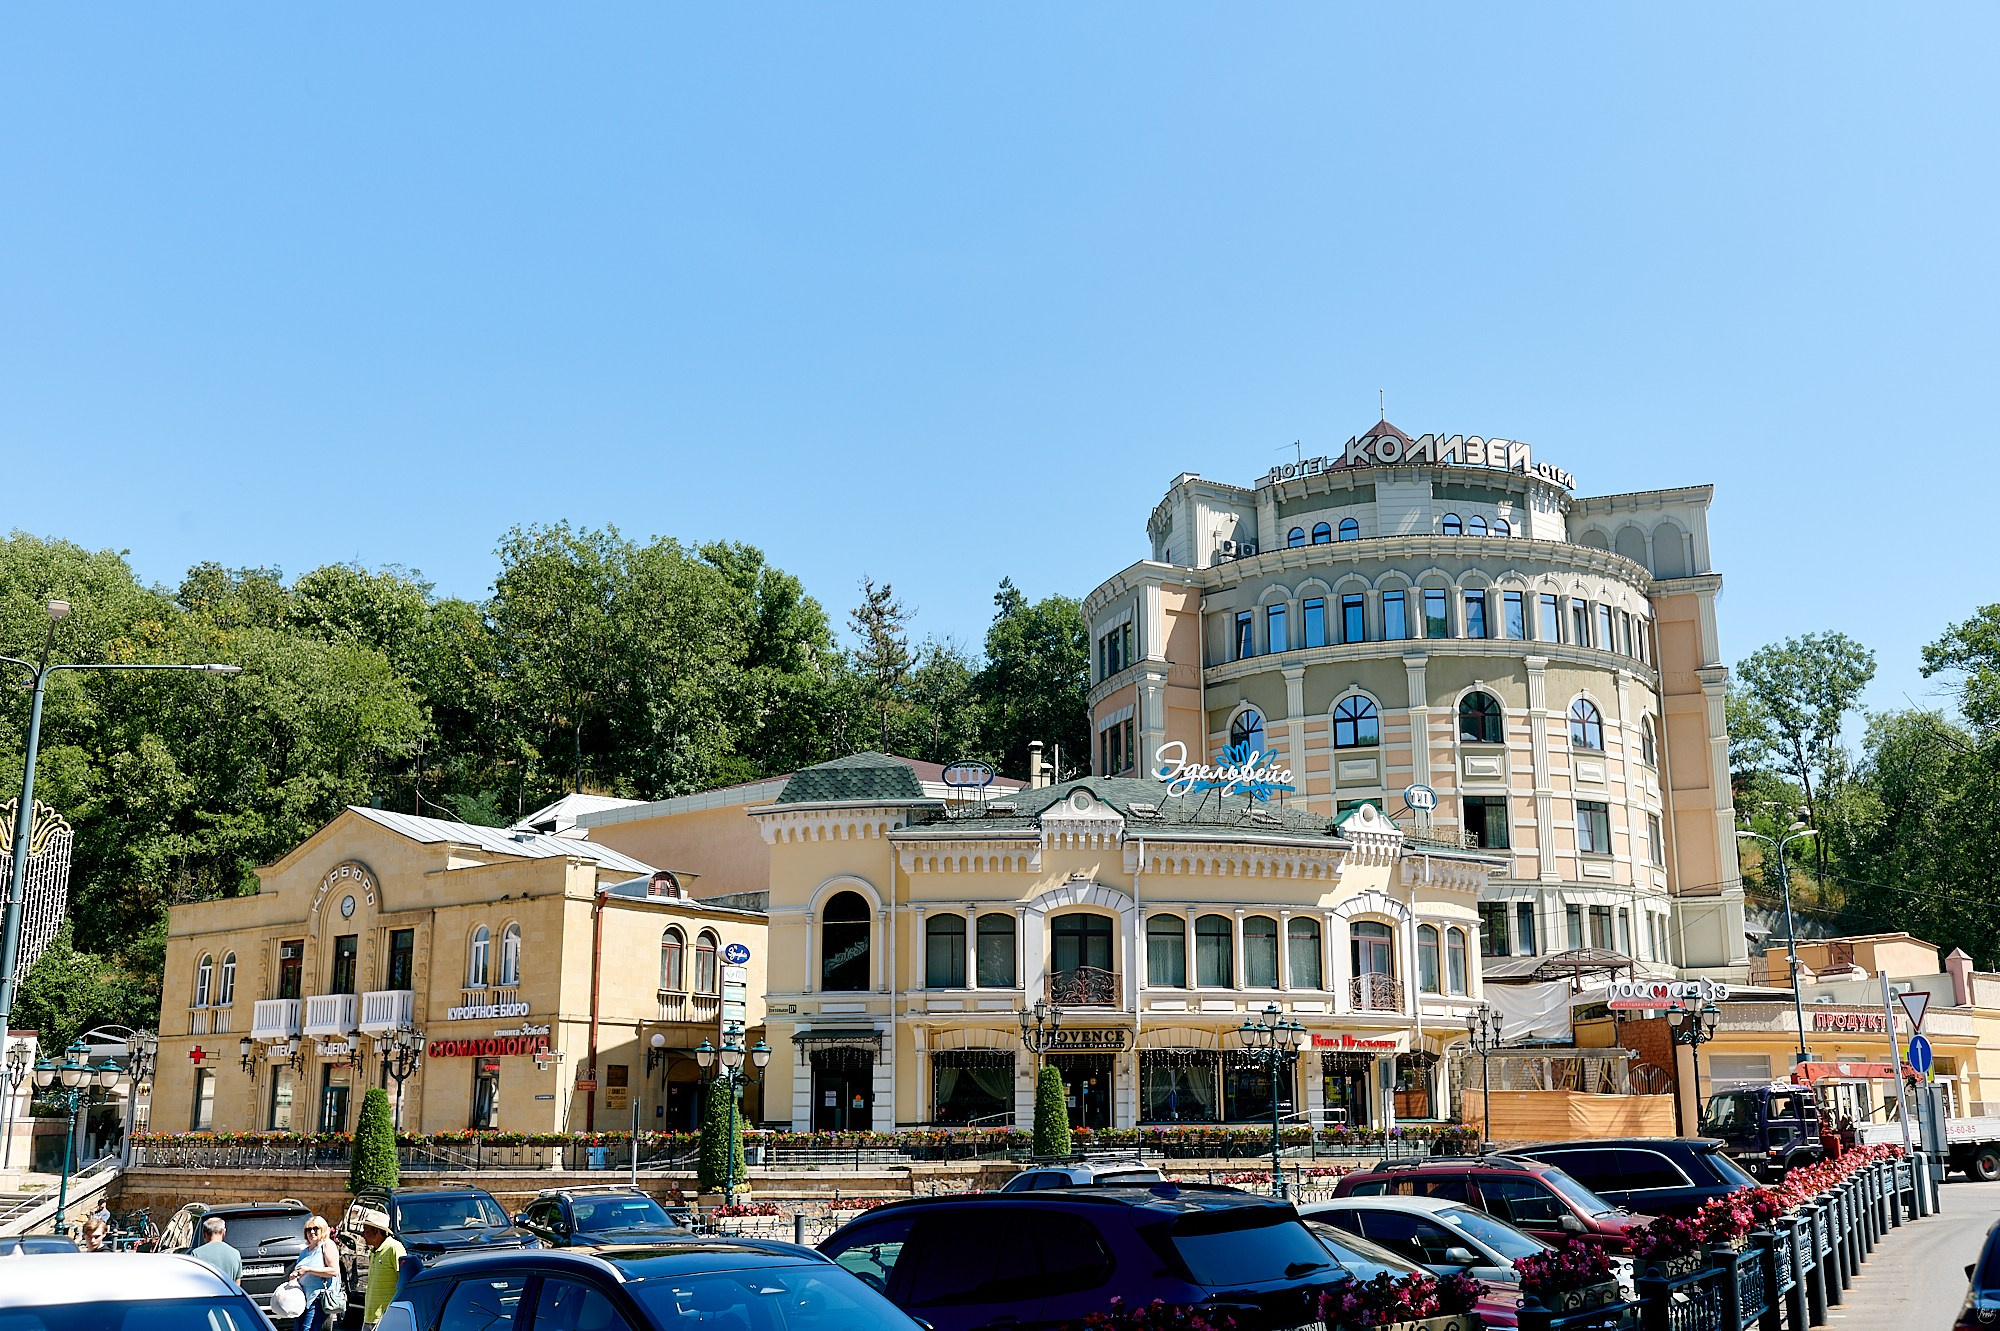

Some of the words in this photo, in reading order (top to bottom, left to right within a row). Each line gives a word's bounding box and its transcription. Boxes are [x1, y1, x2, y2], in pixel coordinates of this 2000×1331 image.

[1345, 433, 1531, 472] КОЛИЗЕЙ
[1268, 456, 1331, 483] HOTEL
[1538, 462, 1577, 490] ОТЕЛЬ
[950, 767, 984, 789] ТЦ
[1151, 740, 1294, 798] Эдельвейс
[312, 866, 375, 913] КУРБЮРО
[448, 1005, 500, 1020] КУРОРТНОЕ
[500, 1002, 530, 1017] БЮРО
[428, 1036, 550, 1058] СТОМАТОЛОГИЯ
